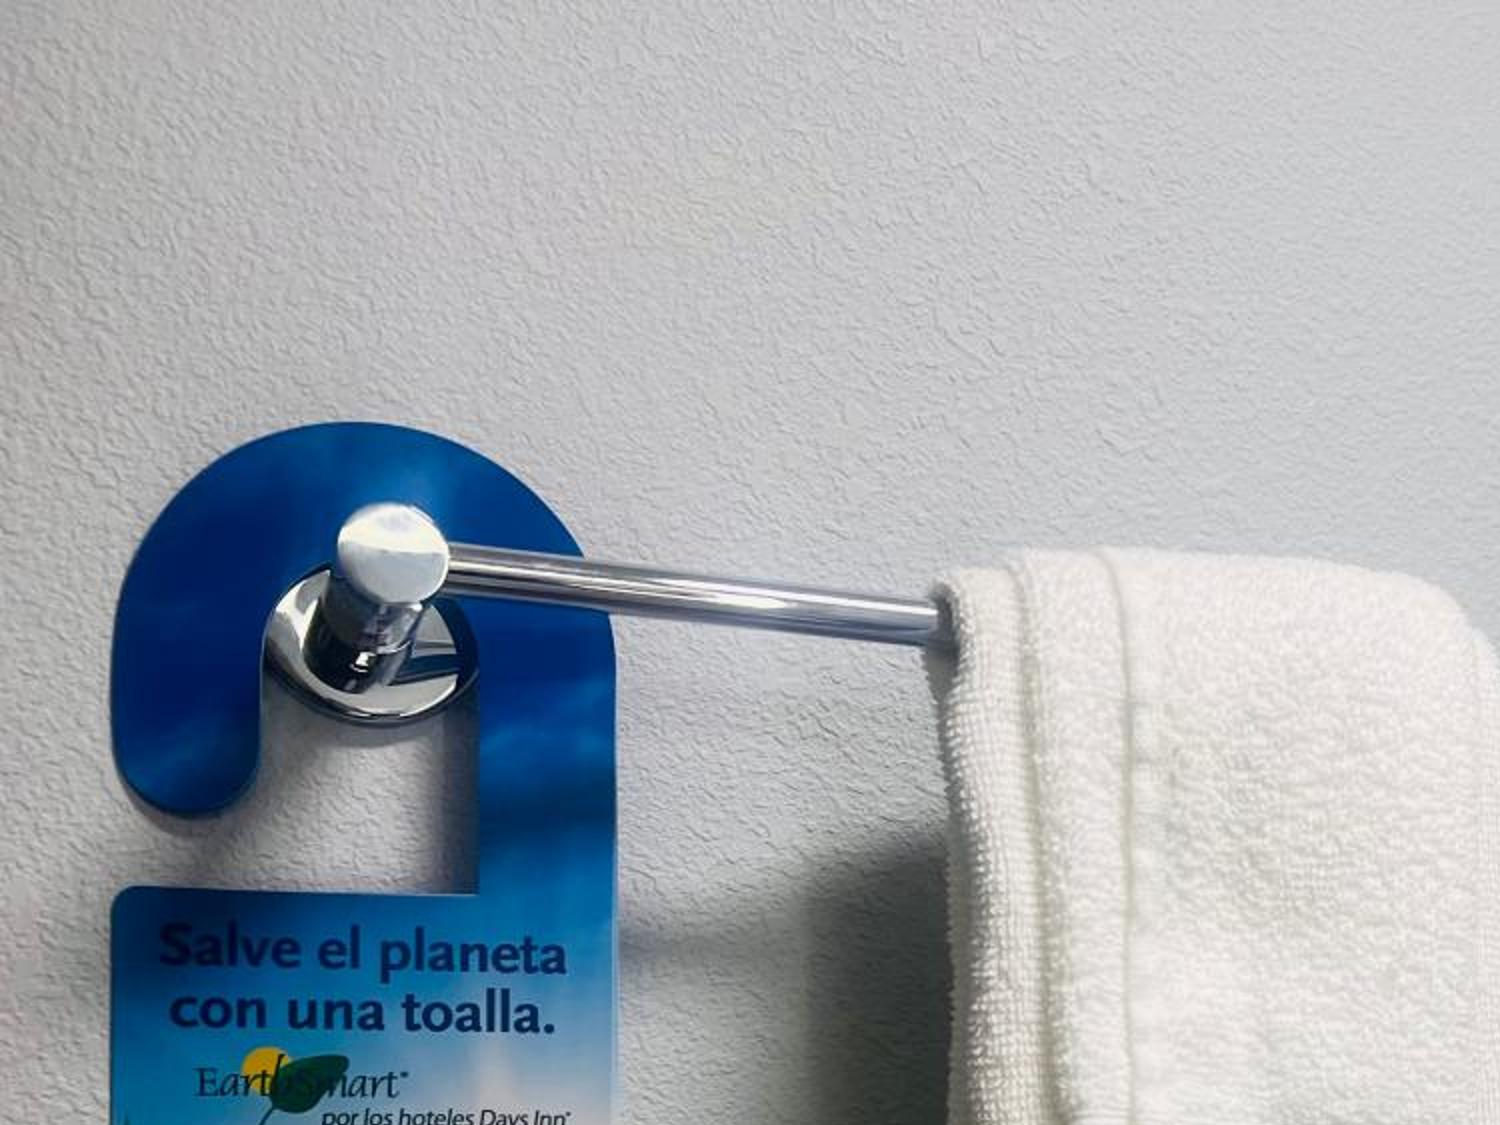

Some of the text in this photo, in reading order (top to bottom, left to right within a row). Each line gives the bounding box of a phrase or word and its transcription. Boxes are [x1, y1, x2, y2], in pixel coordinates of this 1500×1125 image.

[160, 921, 567, 984] Salve el planeta
[169, 988, 555, 1034] con una toalla.
